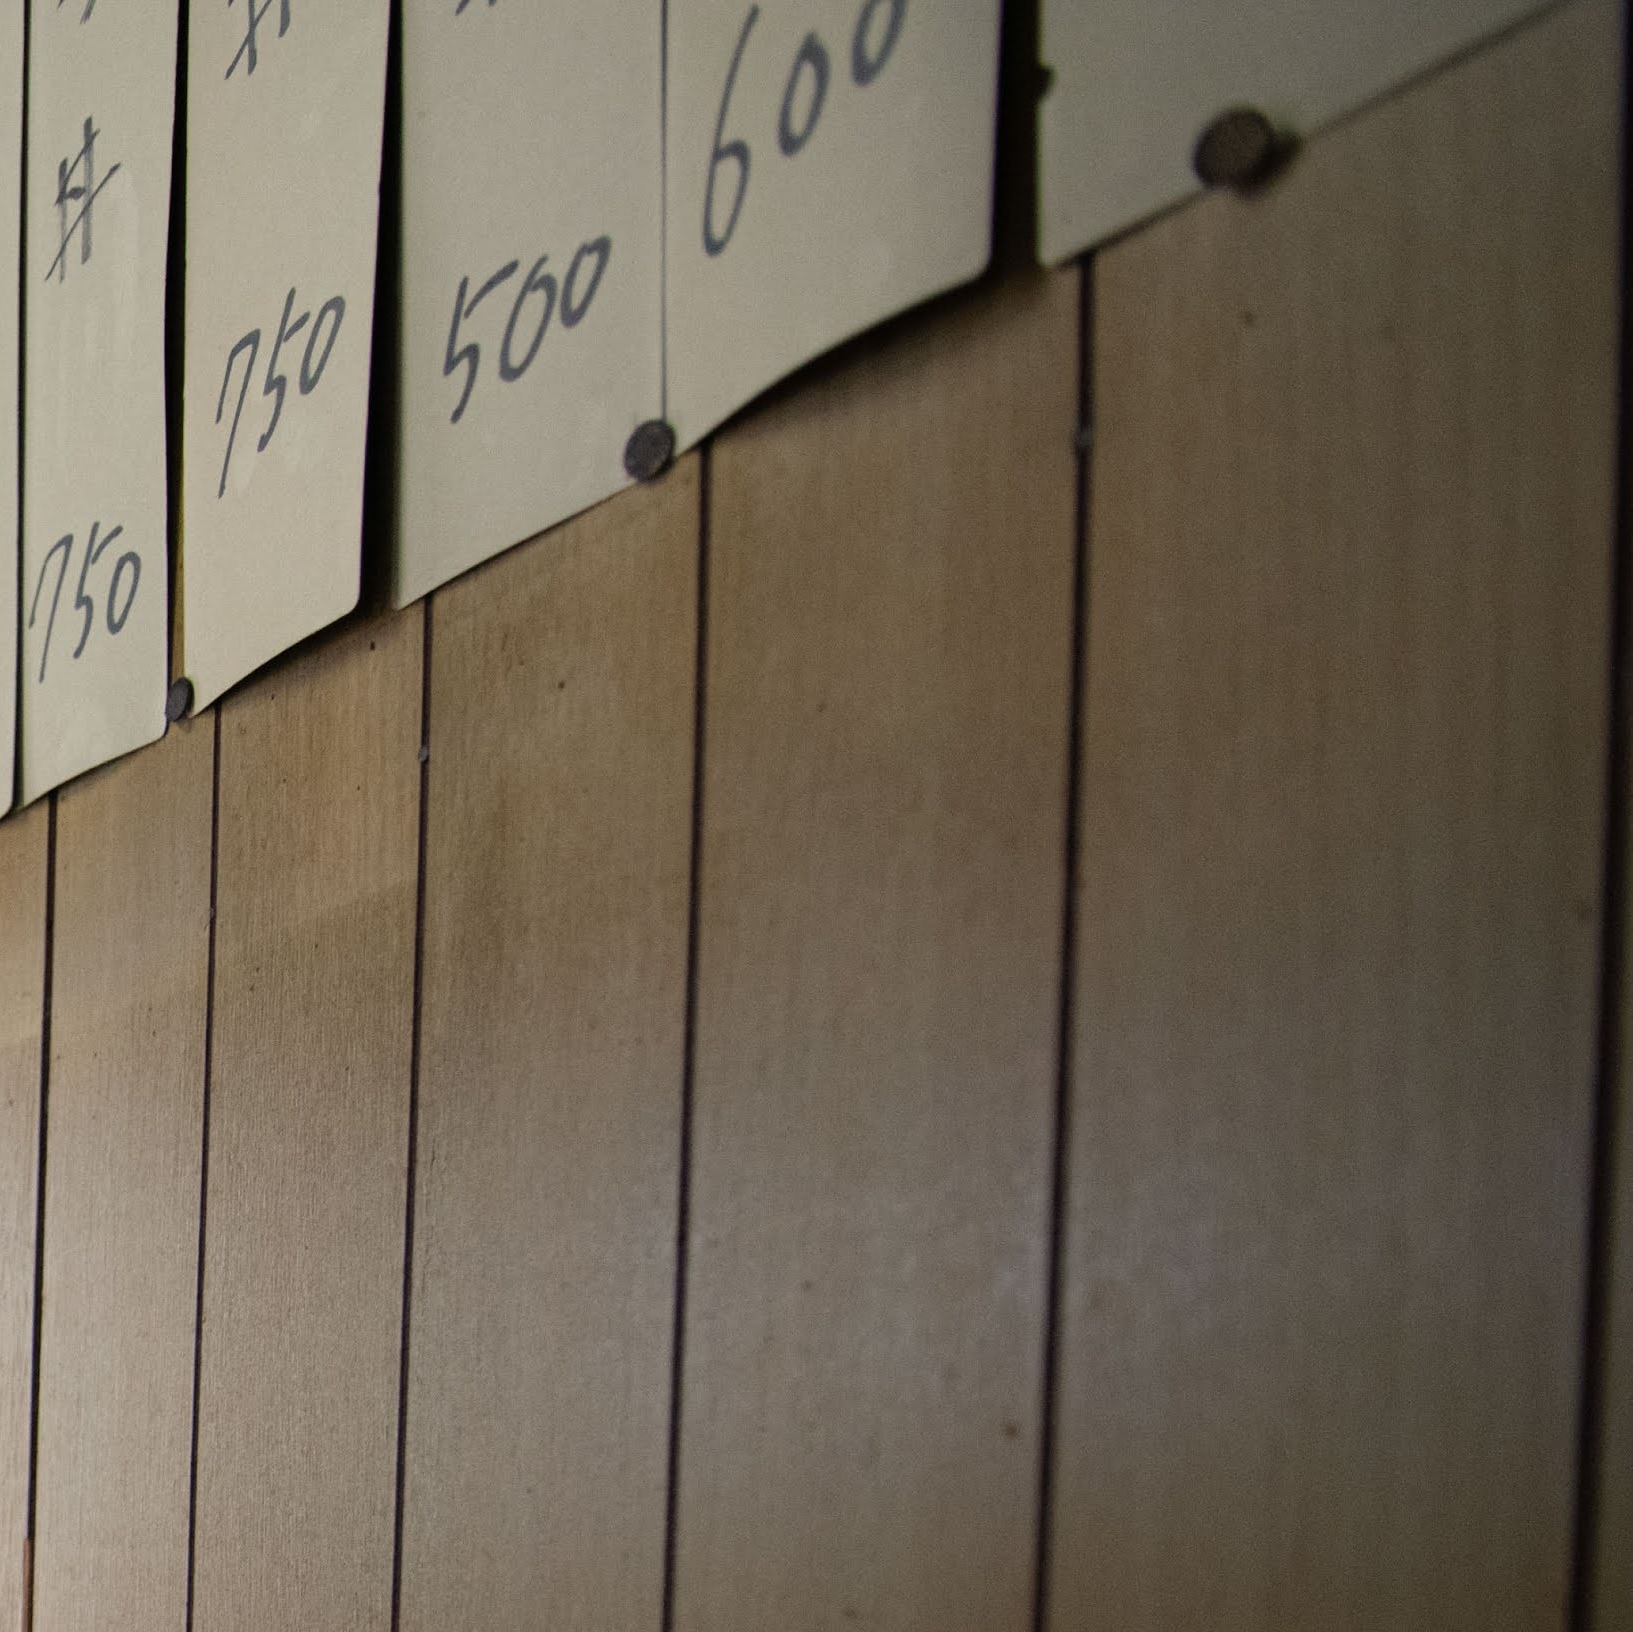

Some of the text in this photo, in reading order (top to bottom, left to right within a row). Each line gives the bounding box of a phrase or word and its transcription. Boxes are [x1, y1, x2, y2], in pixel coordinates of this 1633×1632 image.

[701, 0, 909, 259] 600
[214, 286, 347, 499] 750
[442, 234, 613, 425] 500
[27, 520, 142, 684] 750
